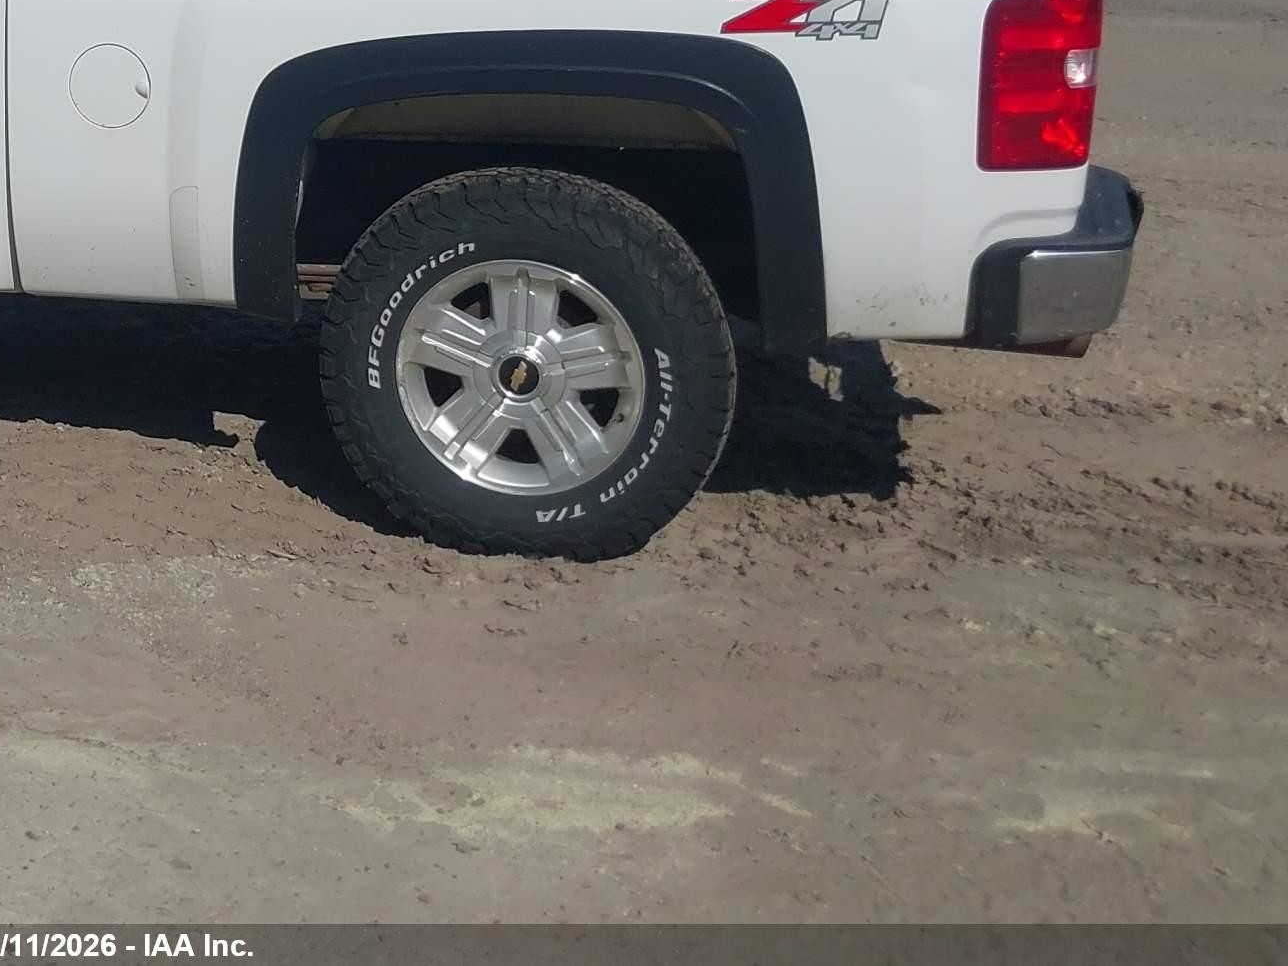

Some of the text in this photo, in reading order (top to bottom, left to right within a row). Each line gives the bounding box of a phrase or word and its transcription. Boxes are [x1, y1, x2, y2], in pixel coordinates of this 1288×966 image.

[367, 242, 475, 389] BFGoodrich
[535, 347, 673, 523] All-Terrain T/A
